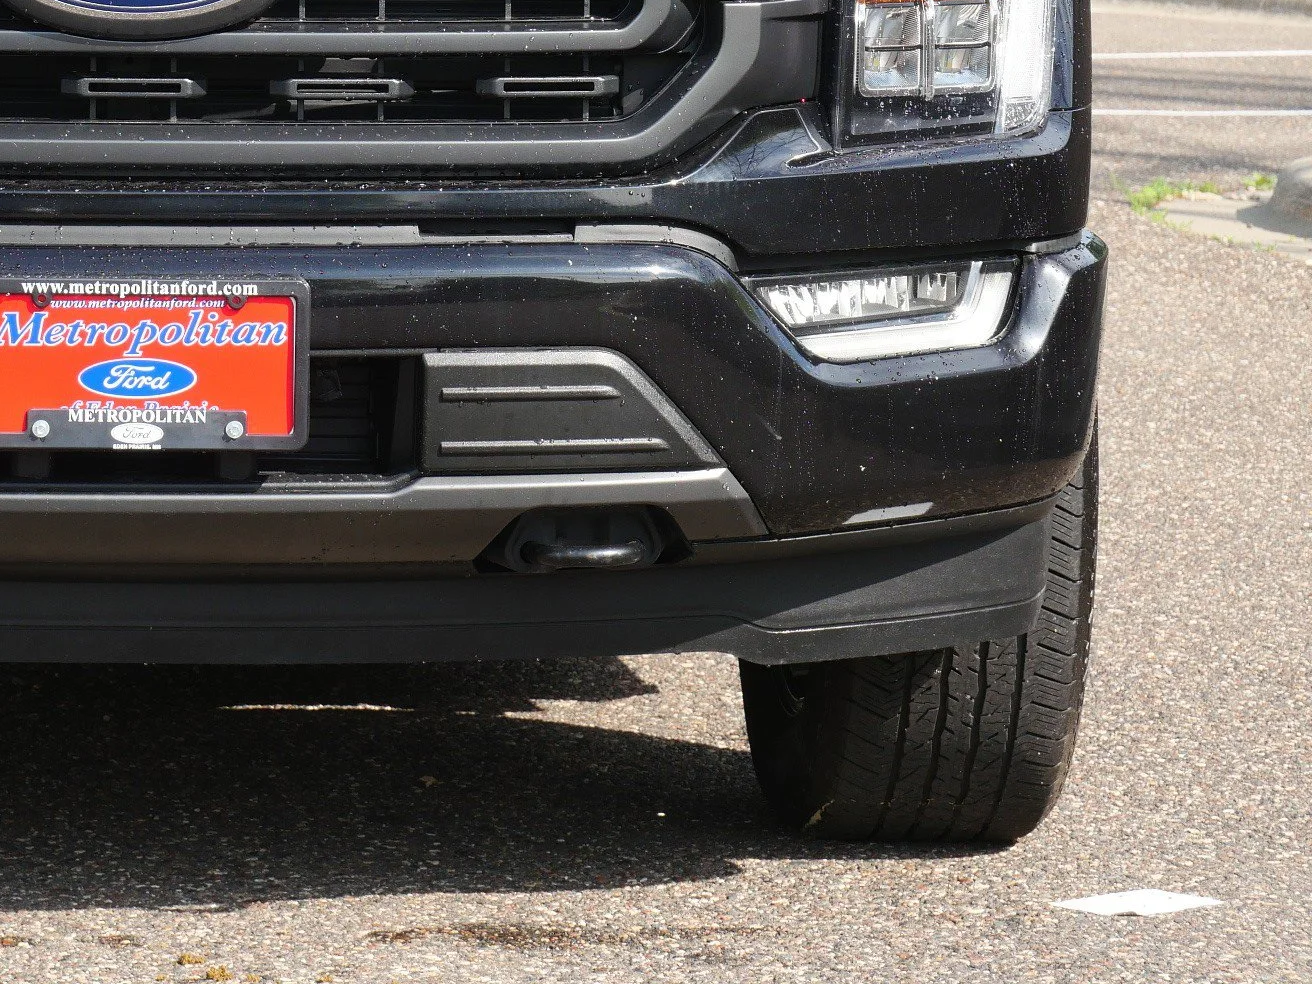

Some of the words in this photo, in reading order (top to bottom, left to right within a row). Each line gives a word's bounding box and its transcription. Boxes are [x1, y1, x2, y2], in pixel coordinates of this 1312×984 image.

[21, 280, 259, 298] www.metropolitanford.com
[50, 297, 226, 311] www.metropolitanford.com
[102, 363, 172, 391] Ford
[68, 409, 207, 424] METROPOLITAN
[122, 426, 152, 439] Ford
